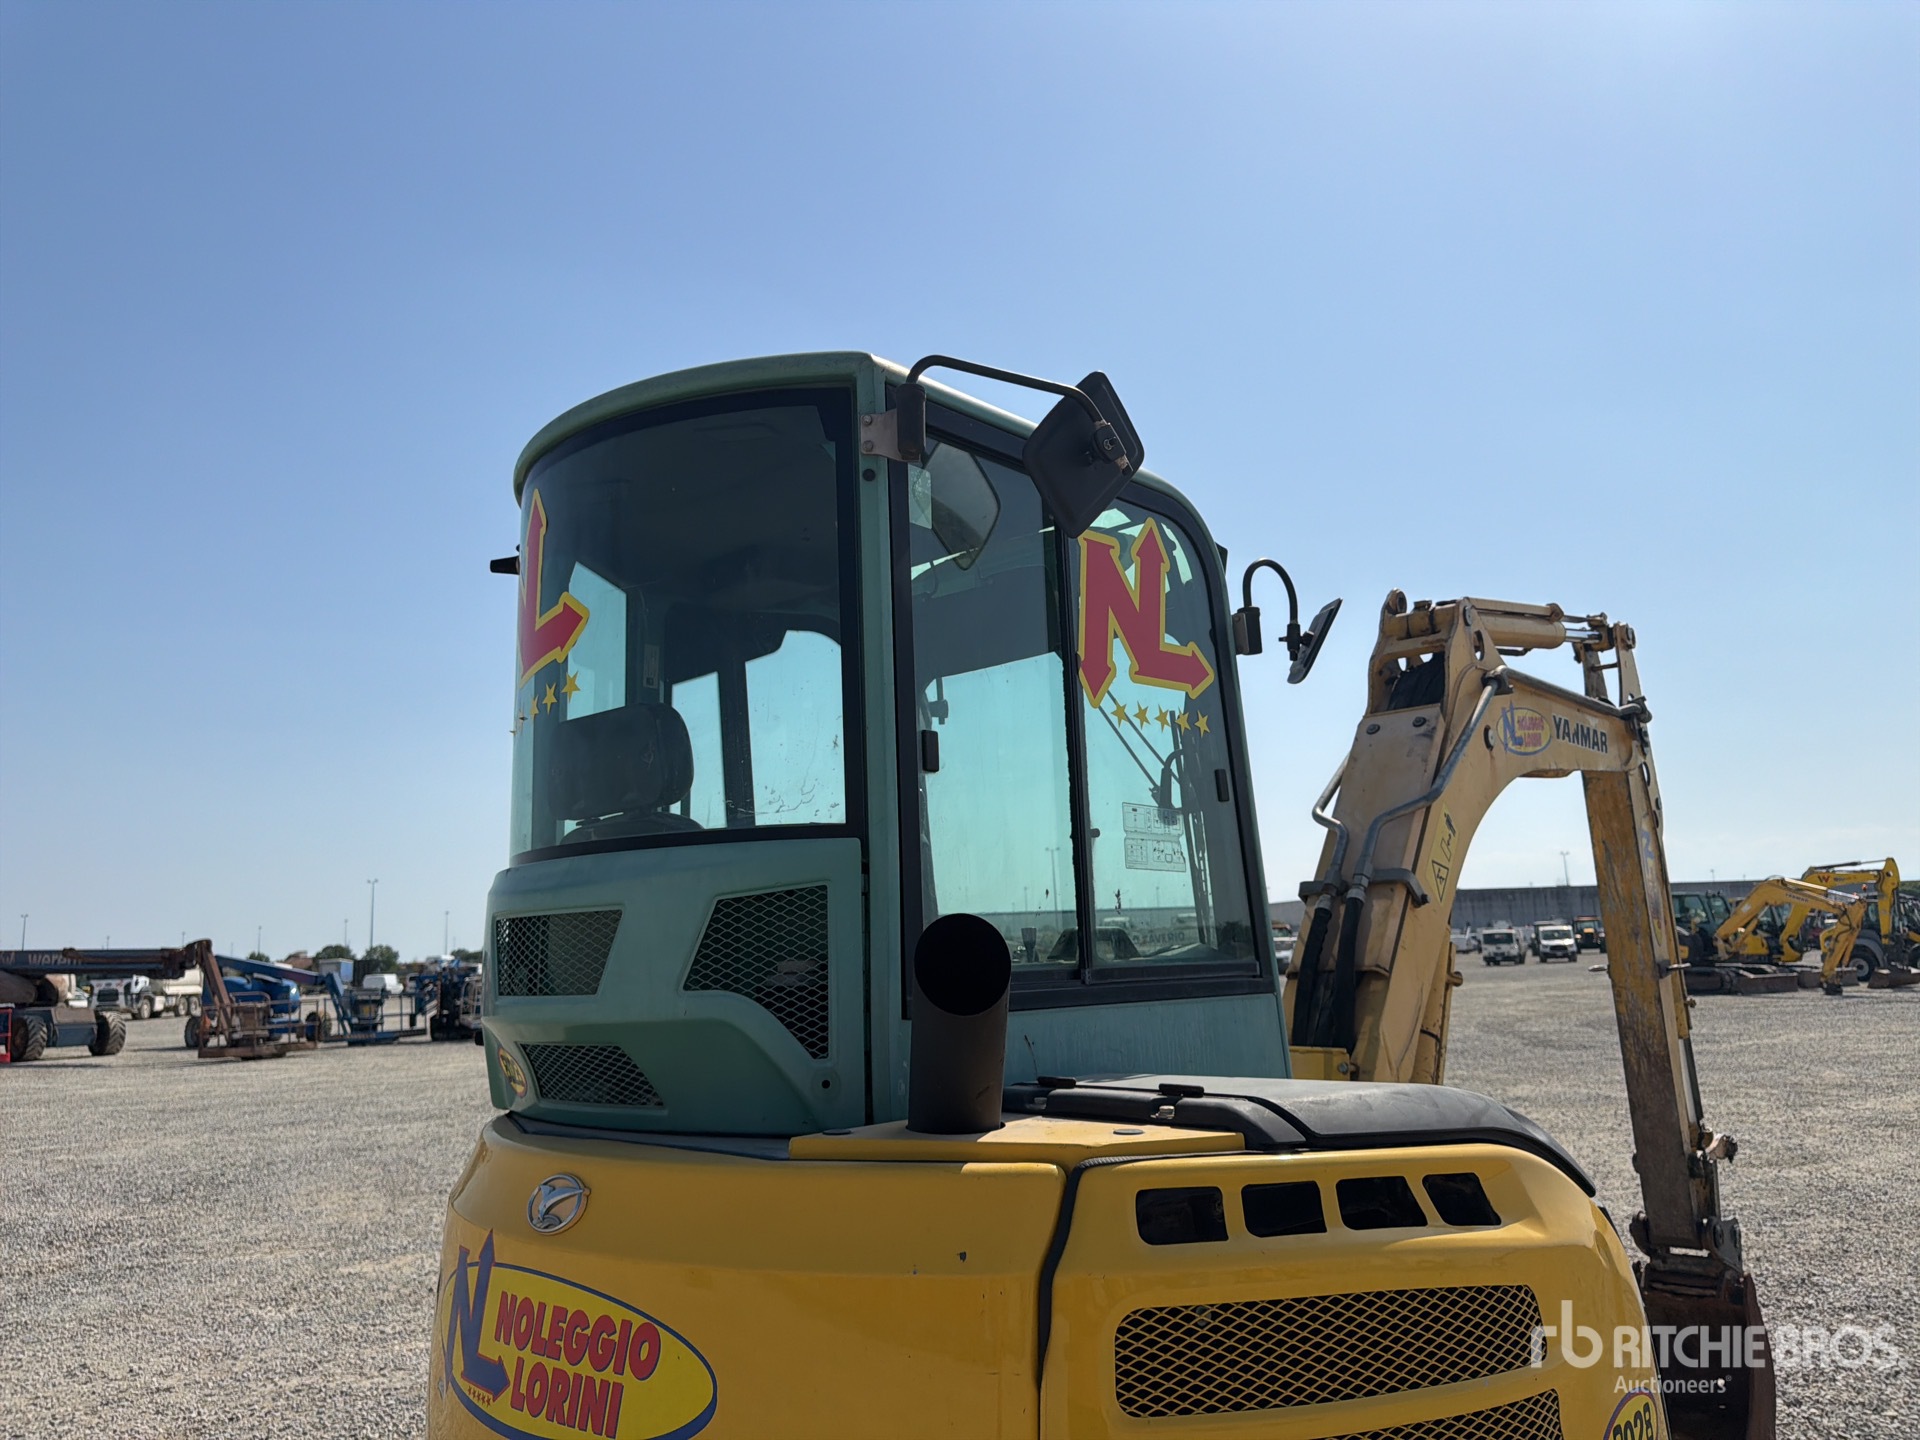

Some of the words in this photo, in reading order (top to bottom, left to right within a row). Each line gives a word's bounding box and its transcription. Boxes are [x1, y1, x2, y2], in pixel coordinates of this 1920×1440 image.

[1552, 715, 1608, 753] YANMAR
[495, 1291, 661, 1381] NOLEGGIO
[510, 1356, 624, 1439] LORINI
